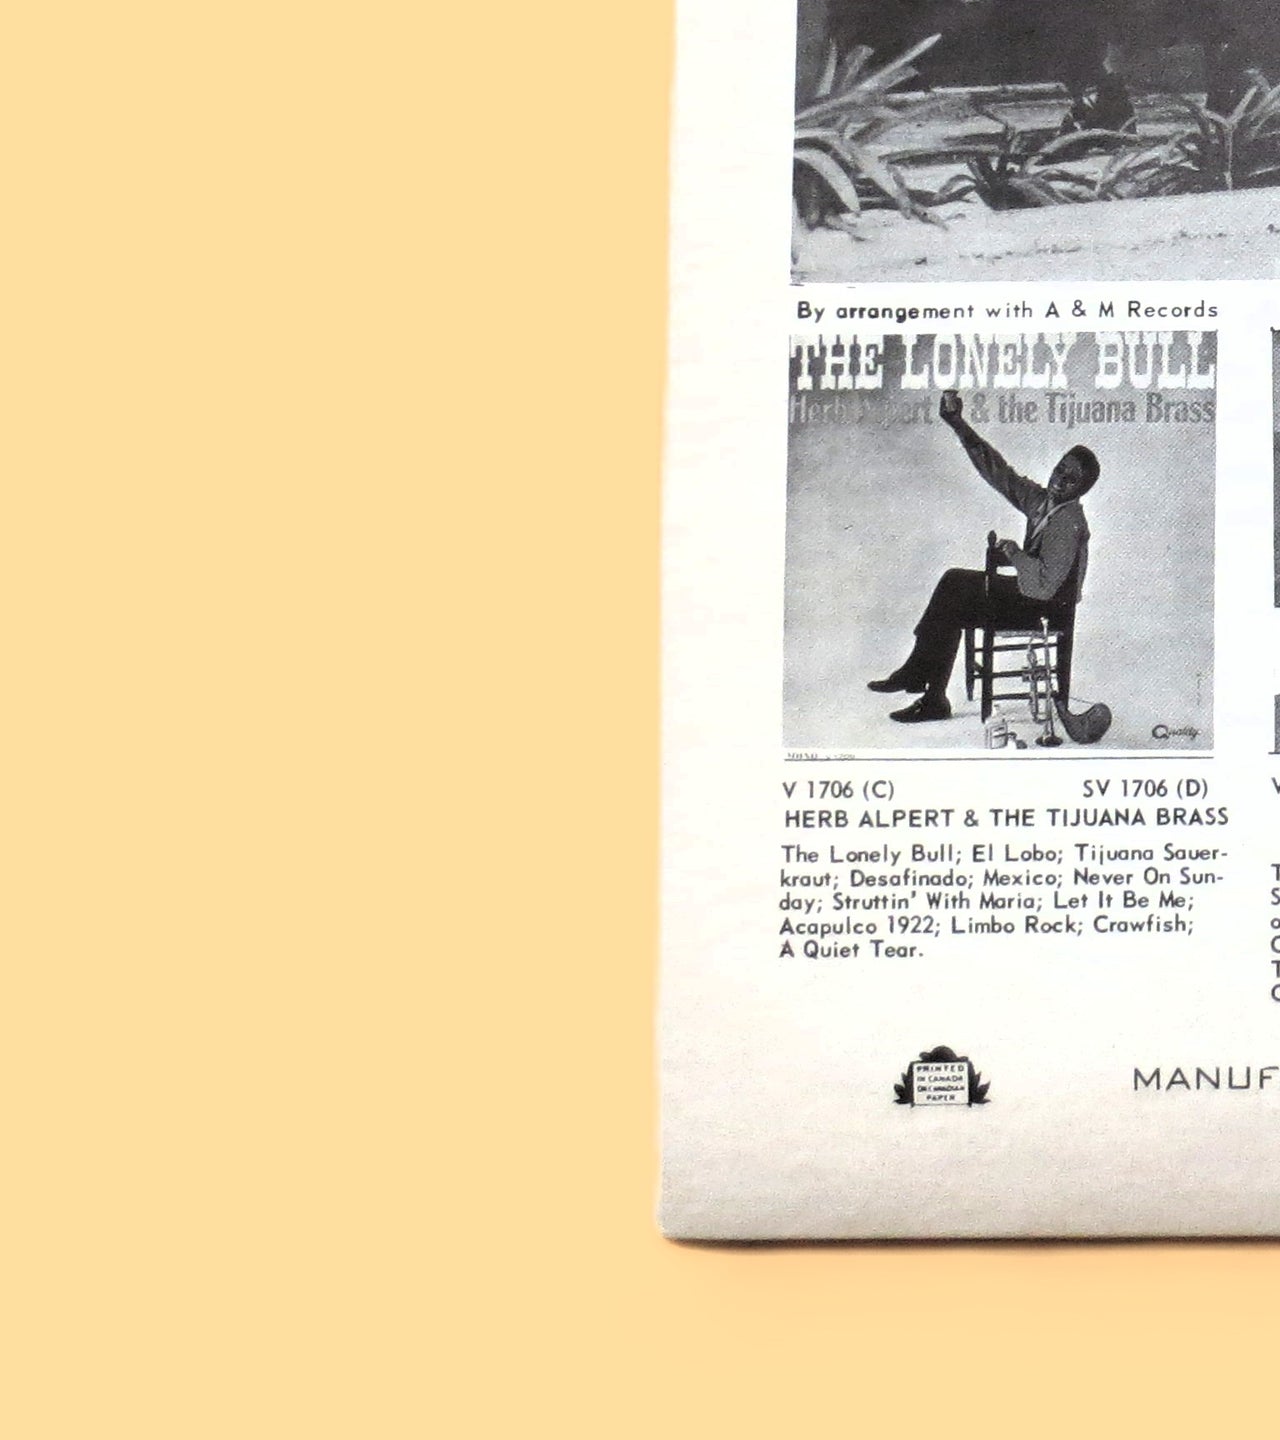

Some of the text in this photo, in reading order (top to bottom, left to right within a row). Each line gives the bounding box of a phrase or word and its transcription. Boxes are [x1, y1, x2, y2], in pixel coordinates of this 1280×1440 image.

[797, 300, 1217, 323] By arrangement with A & M Records
[790, 331, 1217, 390] THE LONELY BULL
[999, 392, 1036, 422] the
[1045, 392, 1135, 428] Tijuana
[1146, 391, 1216, 424] Brass
[782, 780, 894, 801] V 1706 (C)
[1083, 779, 1208, 800] SV 1706 (D)
[786, 807, 1228, 828] HERB ALPERT & THE TIJUANA BRASS
[781, 866, 1223, 890] kraut; Desafinado; Mexico; Never On Sun-
